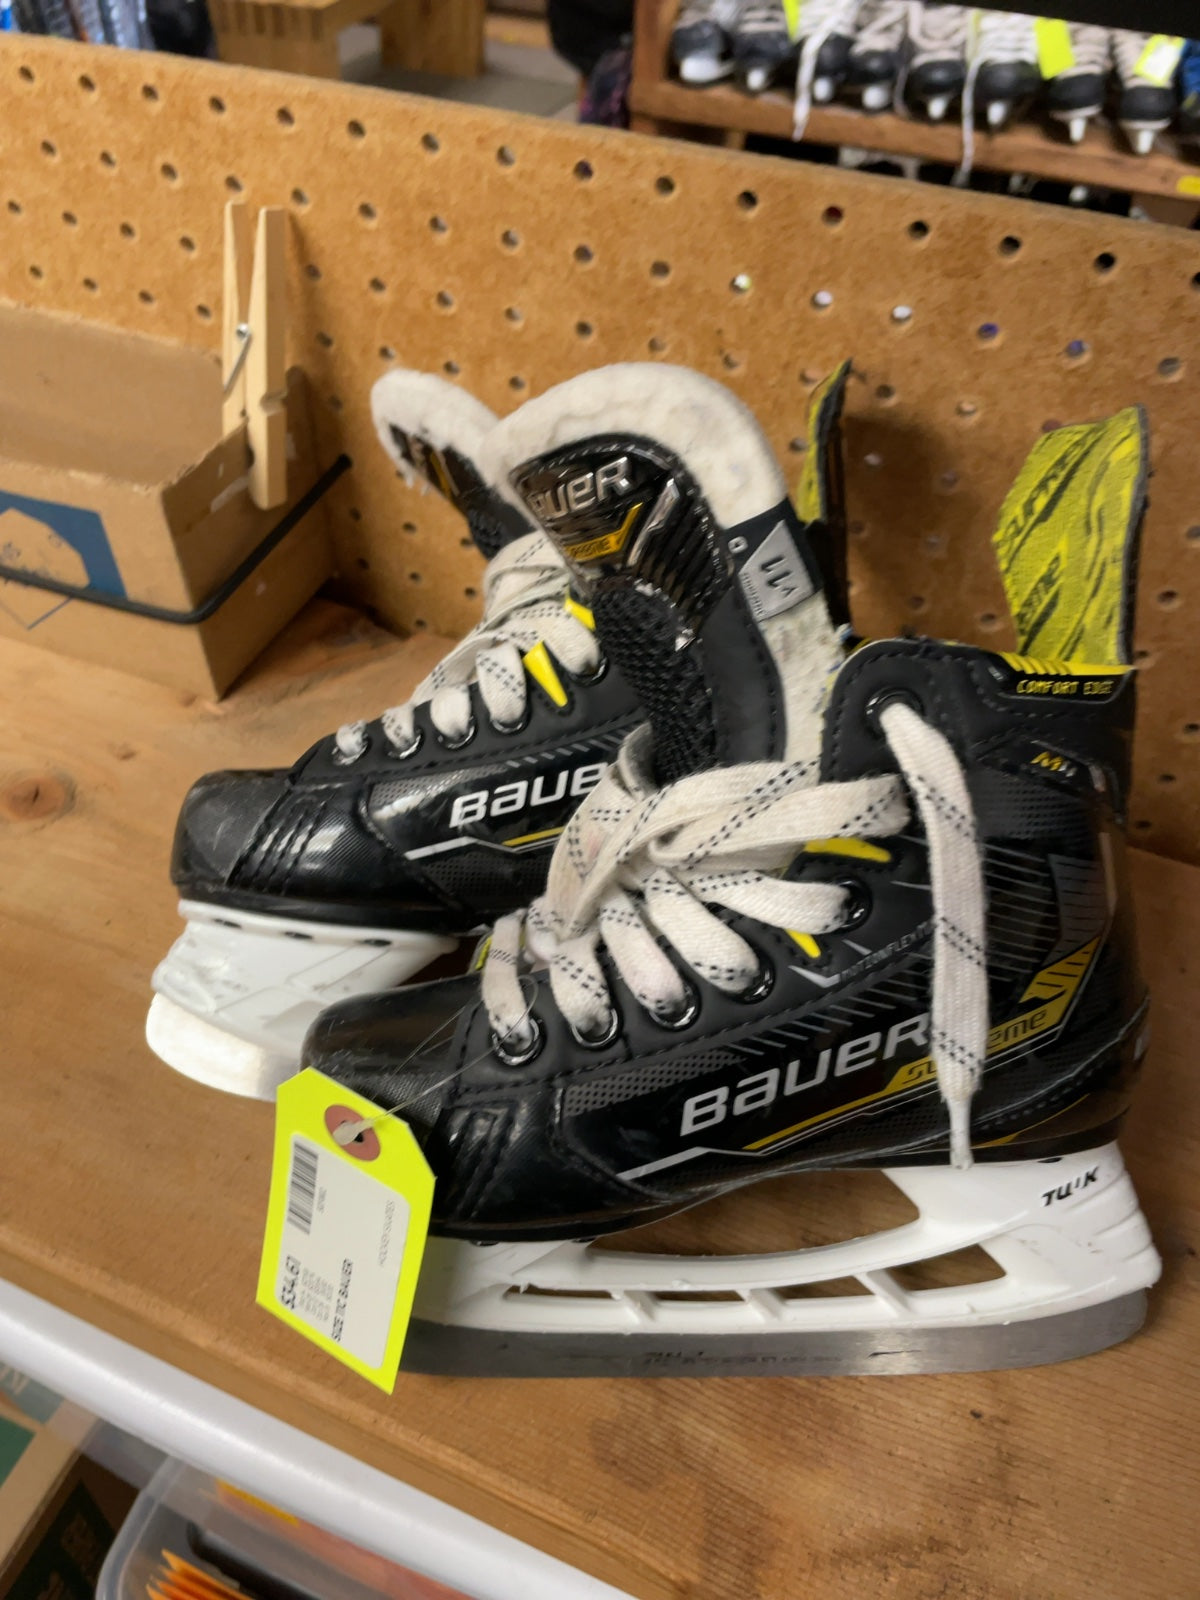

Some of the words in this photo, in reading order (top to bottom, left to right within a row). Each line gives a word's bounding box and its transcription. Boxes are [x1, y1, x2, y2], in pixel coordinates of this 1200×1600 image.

[1016, 679, 1080, 695] COMFORT
[1083, 680, 1115, 696] EDGE
[449, 762, 609, 829] BAUE
[680, 1011, 931, 1137] BAUER
